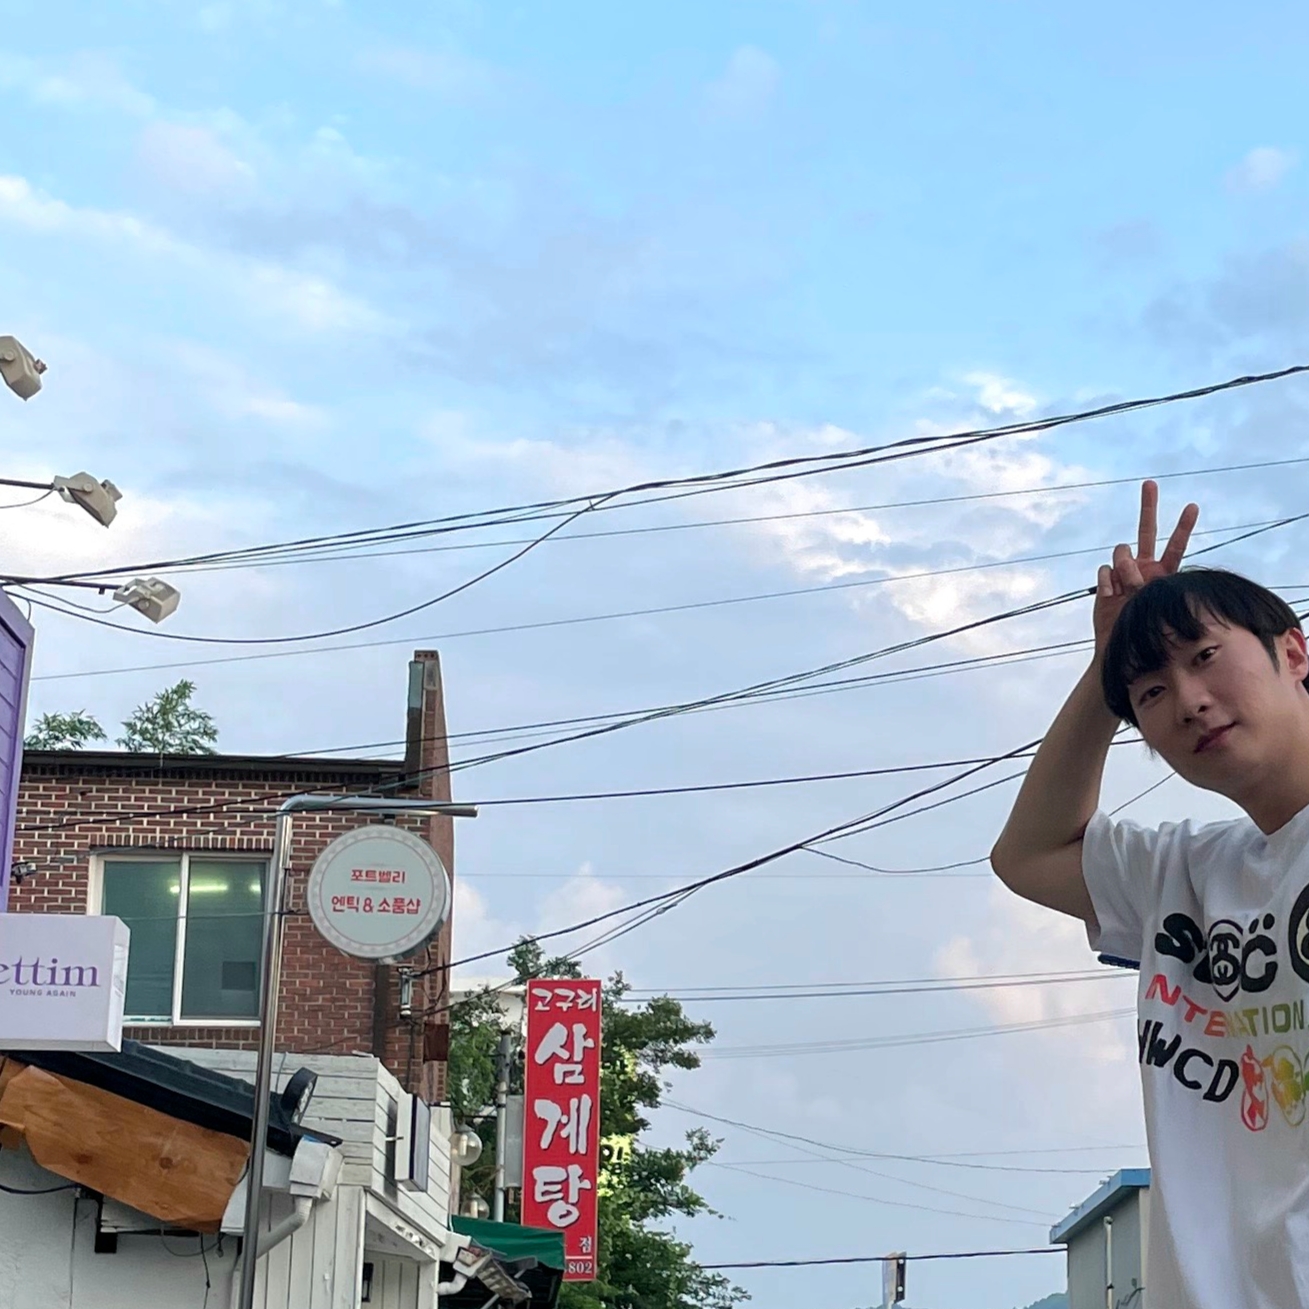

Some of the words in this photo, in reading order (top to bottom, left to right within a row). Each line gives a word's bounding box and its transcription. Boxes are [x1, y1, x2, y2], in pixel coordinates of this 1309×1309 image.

[331, 895, 360, 914] 엔틱
[362, 896, 373, 914] &
[9, 988, 43, 997] YOUNG
[46, 989, 77, 998] AGAIN
[532, 1022, 596, 1228] 삼계탕
[564, 1260, 593, 1275] 802
